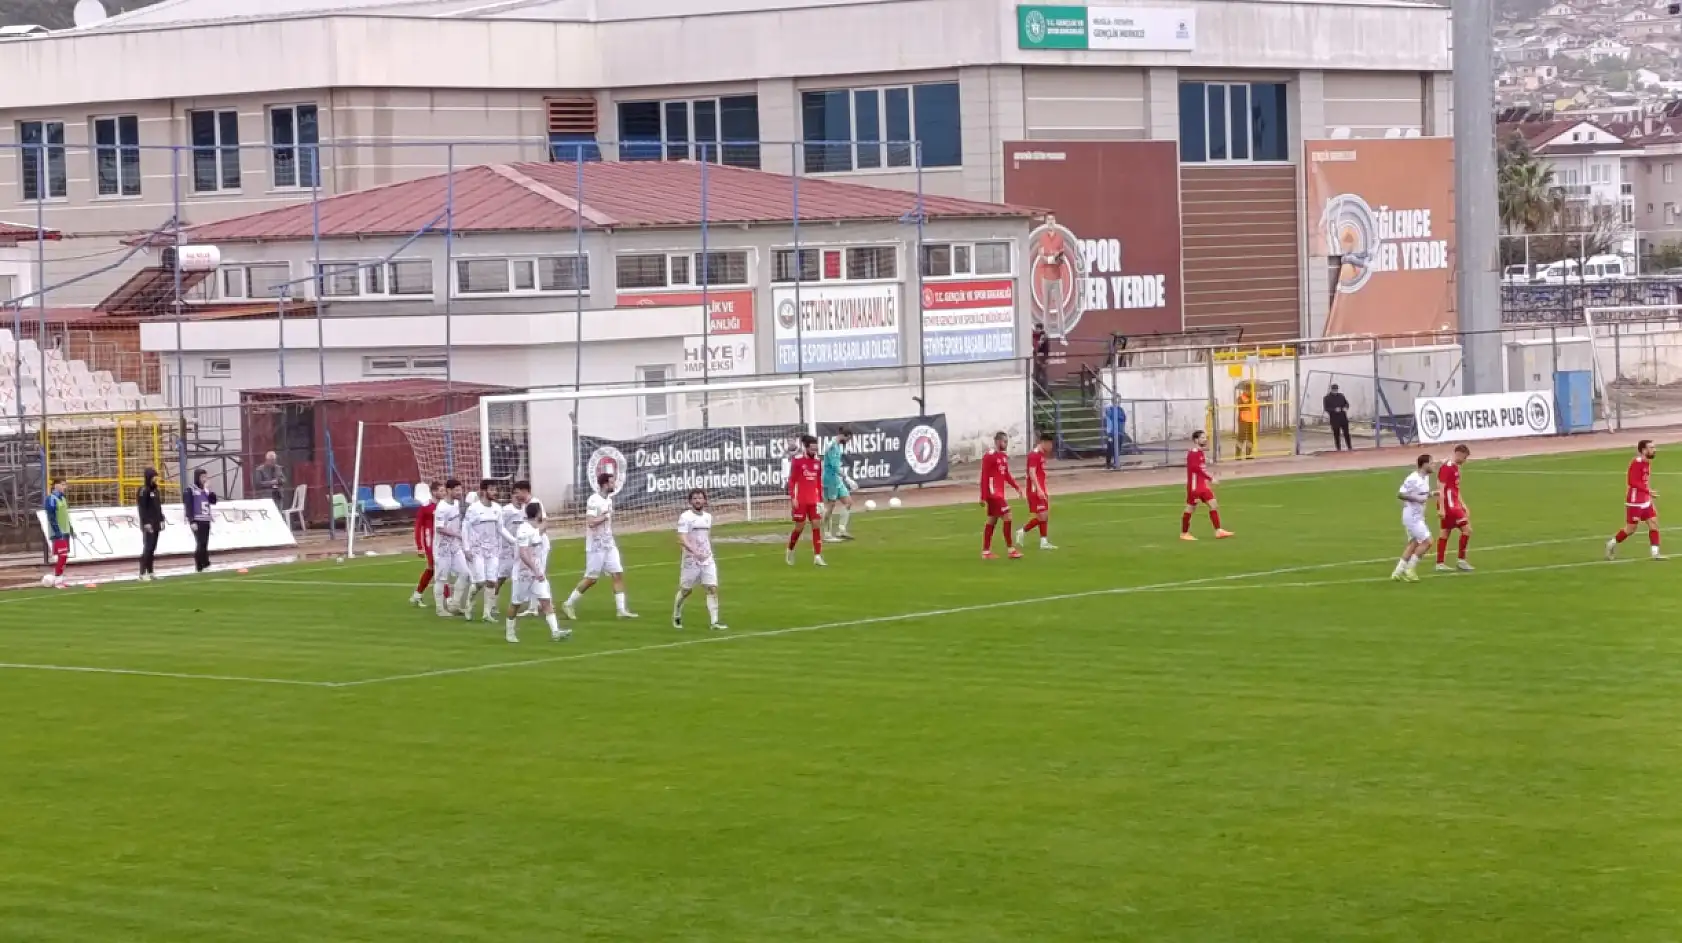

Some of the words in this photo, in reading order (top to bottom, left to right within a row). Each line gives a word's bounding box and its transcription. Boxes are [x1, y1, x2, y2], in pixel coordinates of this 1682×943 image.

[1075, 238, 1122, 273] SPOR
[1401, 240, 1448, 270] YERDE
[722, 300, 734, 313] VE
[1111, 274, 1166, 309] YERDE
[1445, 408, 1499, 431] BAVYERA
[1501, 406, 1525, 428] PUB
[668, 441, 720, 464] Lokman
[724, 438, 766, 461] Hekim
[646, 466, 746, 493] Desteklerinden
[853, 459, 891, 480] Ederiz
